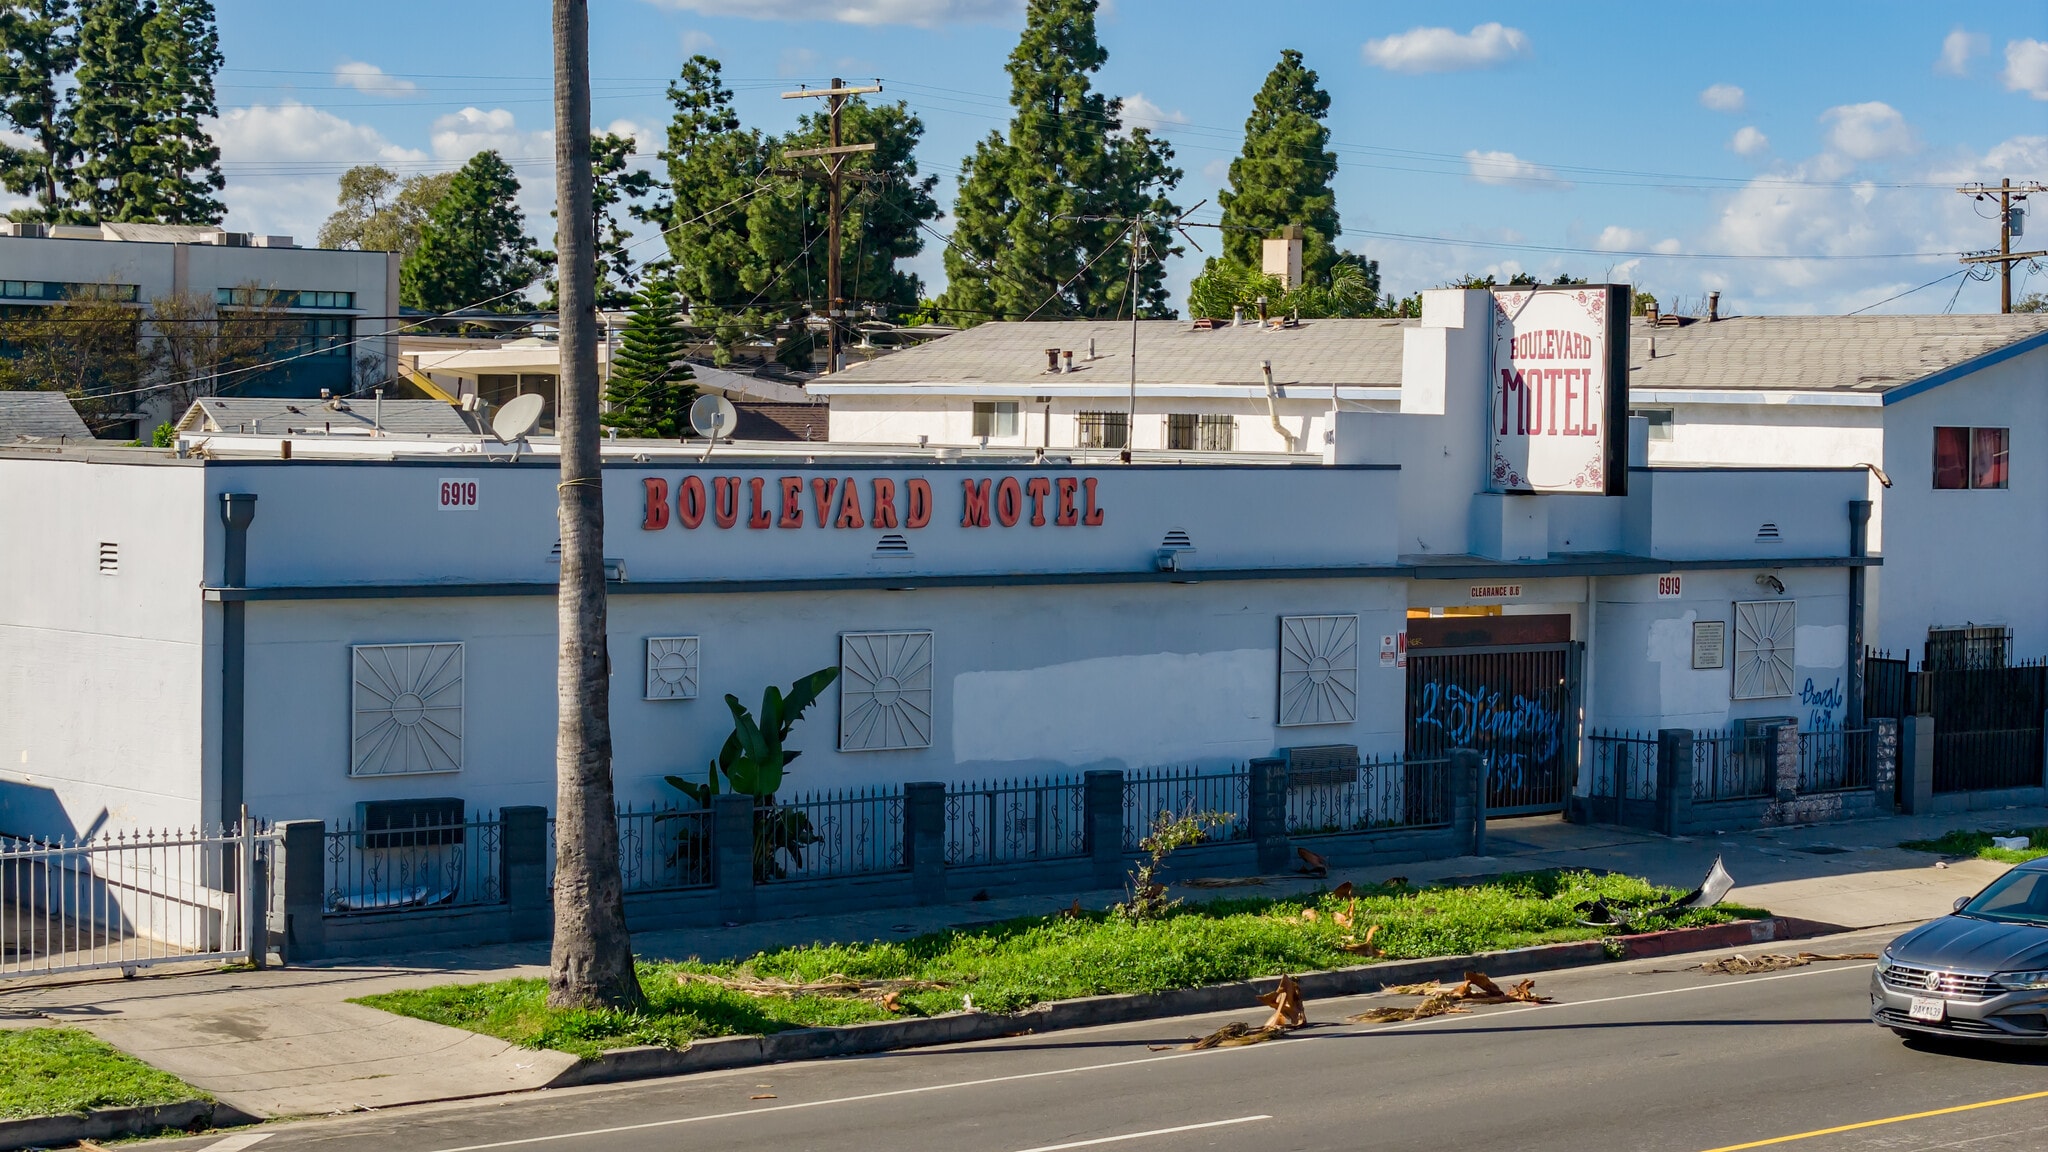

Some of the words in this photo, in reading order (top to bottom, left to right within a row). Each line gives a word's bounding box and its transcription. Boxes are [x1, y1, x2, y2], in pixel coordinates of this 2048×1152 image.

[1510, 329, 1592, 360] BOULEVARD
[1500, 368, 1598, 437] MOTEL
[441, 482, 476, 506] 6919
[643, 475, 933, 531] BOULEVARD
[960, 476, 1104, 529] MOTEL
[1471, 586, 1507, 598] CLEARANCE
[1659, 576, 1680, 595] 6919
